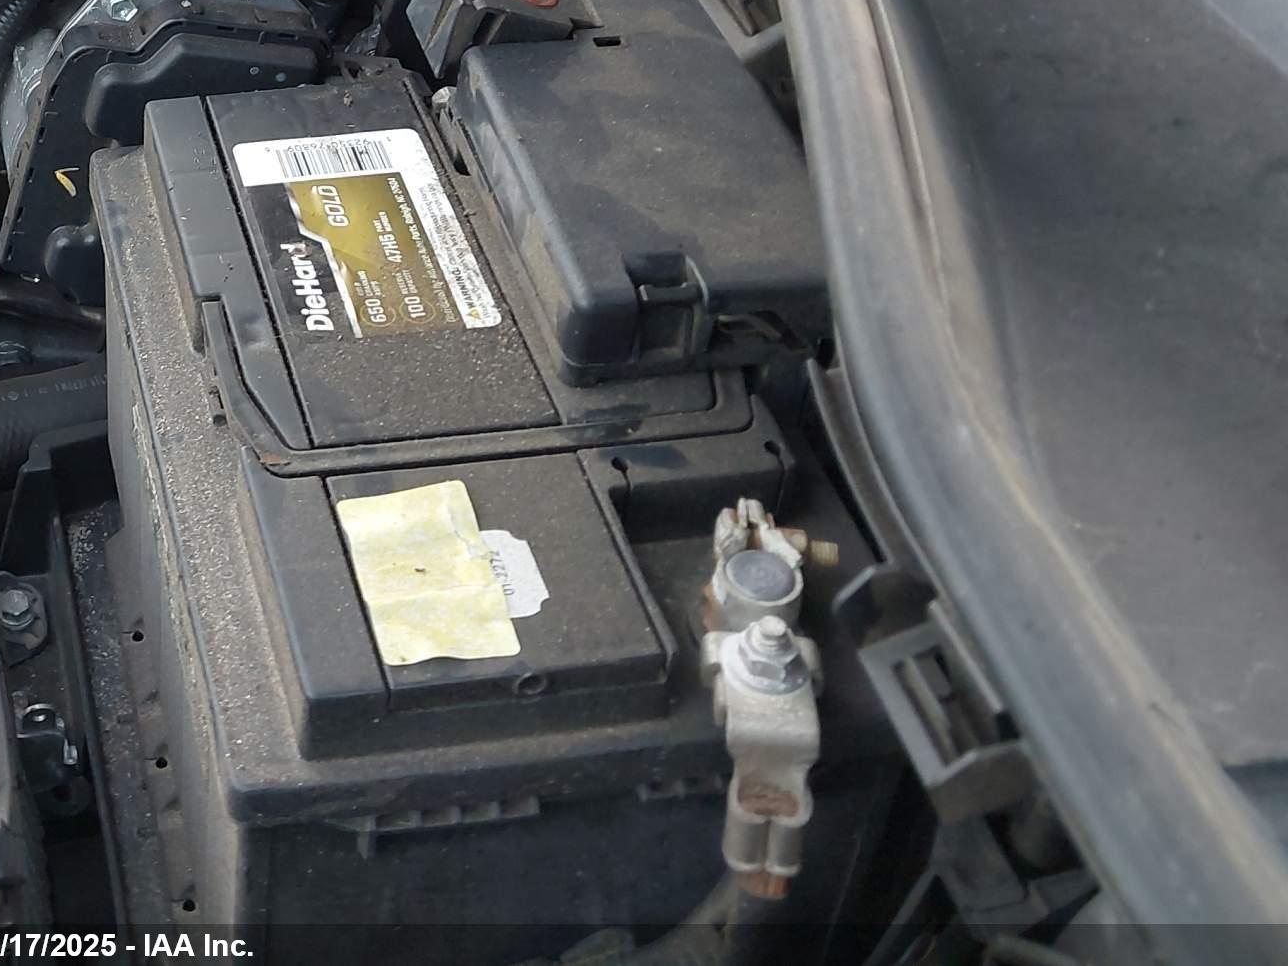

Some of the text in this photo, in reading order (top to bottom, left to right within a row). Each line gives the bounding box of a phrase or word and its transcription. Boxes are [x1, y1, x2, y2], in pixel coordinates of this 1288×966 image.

[311, 184, 350, 228] GOLD
[279, 242, 335, 331] DieHard
[364, 297, 388, 324] 650
[404, 295, 426, 319] 100
